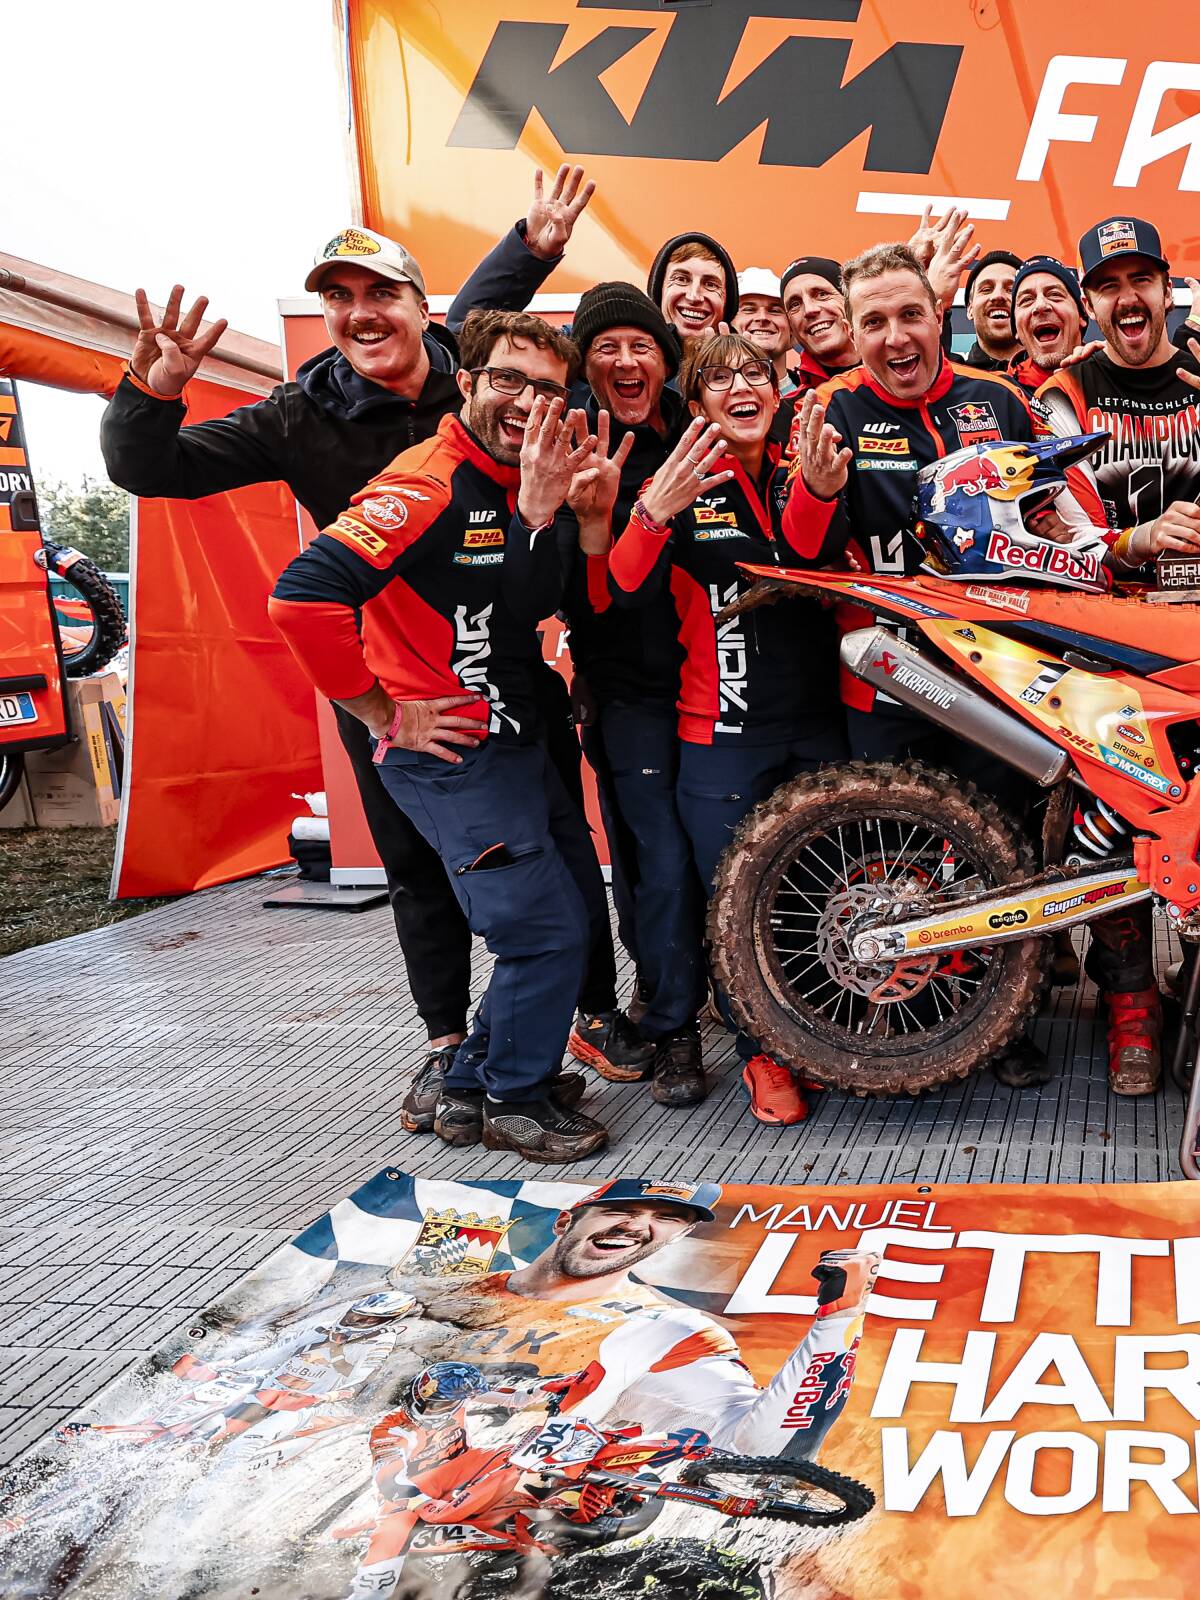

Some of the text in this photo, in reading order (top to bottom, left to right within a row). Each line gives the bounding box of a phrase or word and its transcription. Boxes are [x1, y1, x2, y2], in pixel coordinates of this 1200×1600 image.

[445, 0, 964, 174] KTM
[345, 230, 370, 241] Bass
[346, 236, 364, 245] Pro
[863, 440, 908, 452] DHL
[871, 459, 916, 470] MOTOREX
[336, 518, 380, 550] DHL
[466, 532, 503, 544] DHL
[472, 553, 505, 565] MOTORE
[986, 532, 1098, 581] Red Bull
[1020, 688, 1044, 704] 304
[1055, 725, 1097, 754] DHL
[1112, 741, 1142, 761] BRISK
[1118, 759, 1168, 791] MOTOREX
[933, 924, 974, 940] brembo
[729, 1200, 953, 1231] MANUEL
[780, 1350, 837, 1430] Red Bull
[521, 1422, 572, 1459] 304
[614, 1452, 643, 1463] DHL
